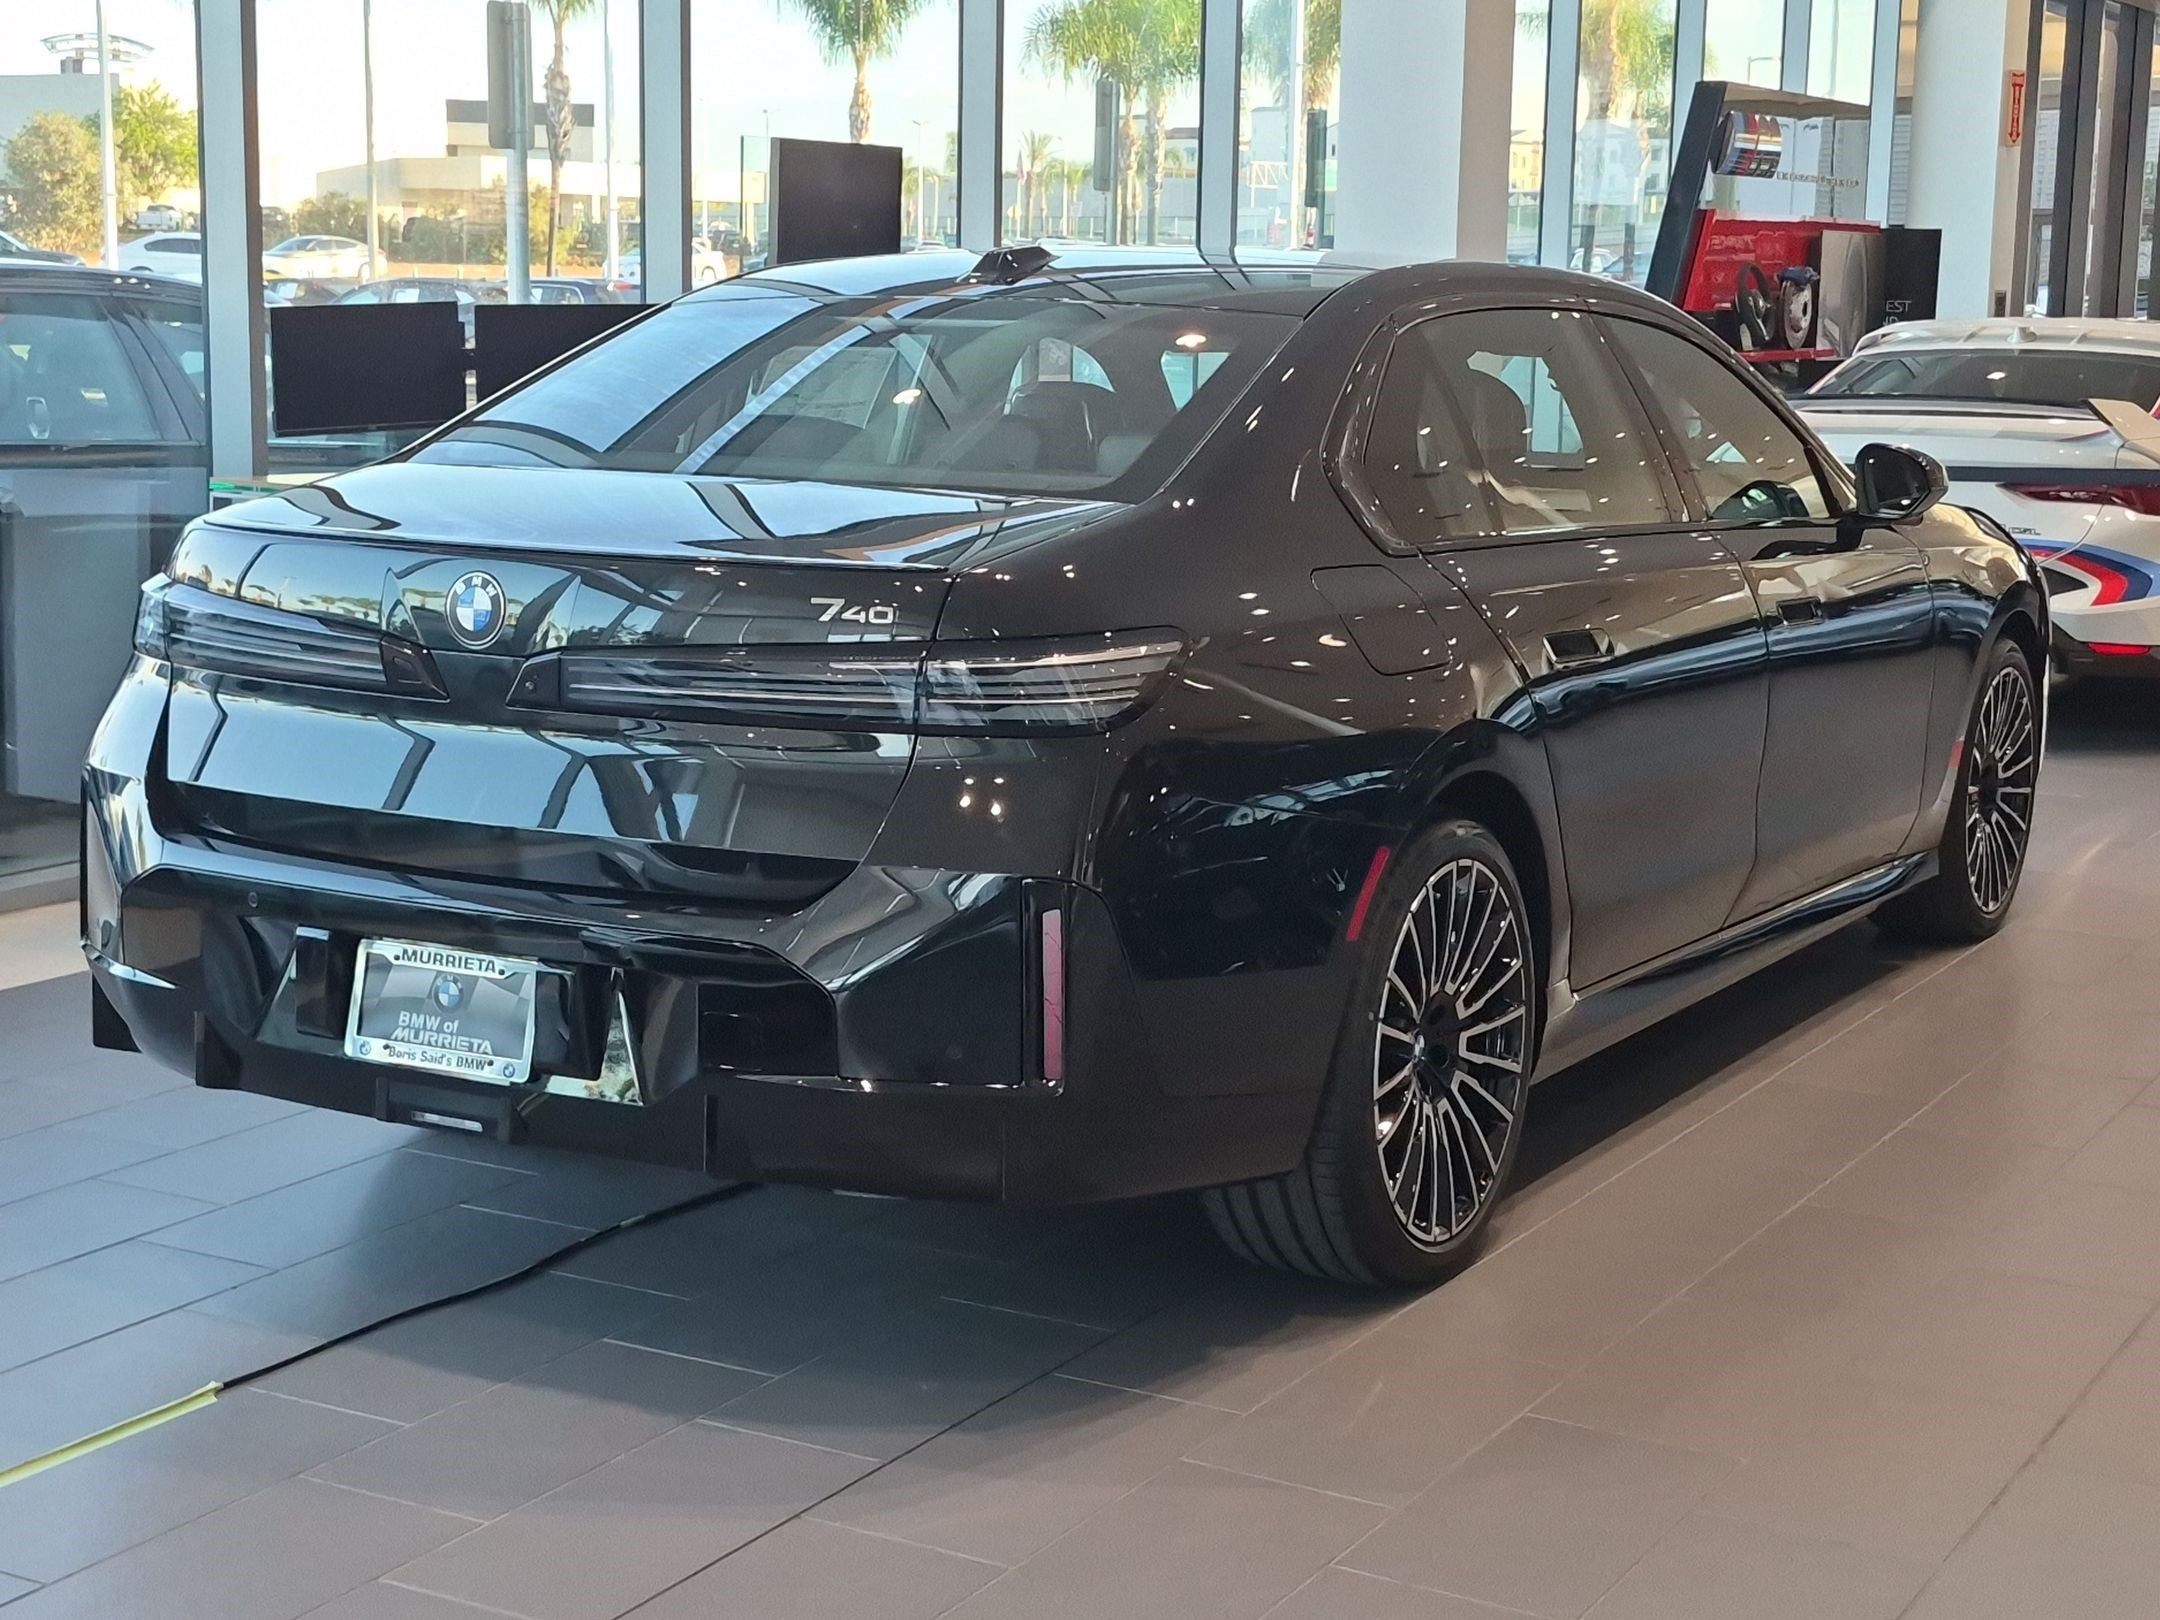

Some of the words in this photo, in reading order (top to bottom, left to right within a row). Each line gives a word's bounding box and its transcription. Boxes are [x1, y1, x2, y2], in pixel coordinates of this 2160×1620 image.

[401, 948, 496, 973] MURRIETA
[398, 1010, 440, 1031] BMW
[443, 1019, 459, 1034] of
[390, 1026, 494, 1055] MURRIETA
[388, 1046, 417, 1061] Boris
[420, 1050, 452, 1067] Said's
[456, 1055, 486, 1071] BMW
